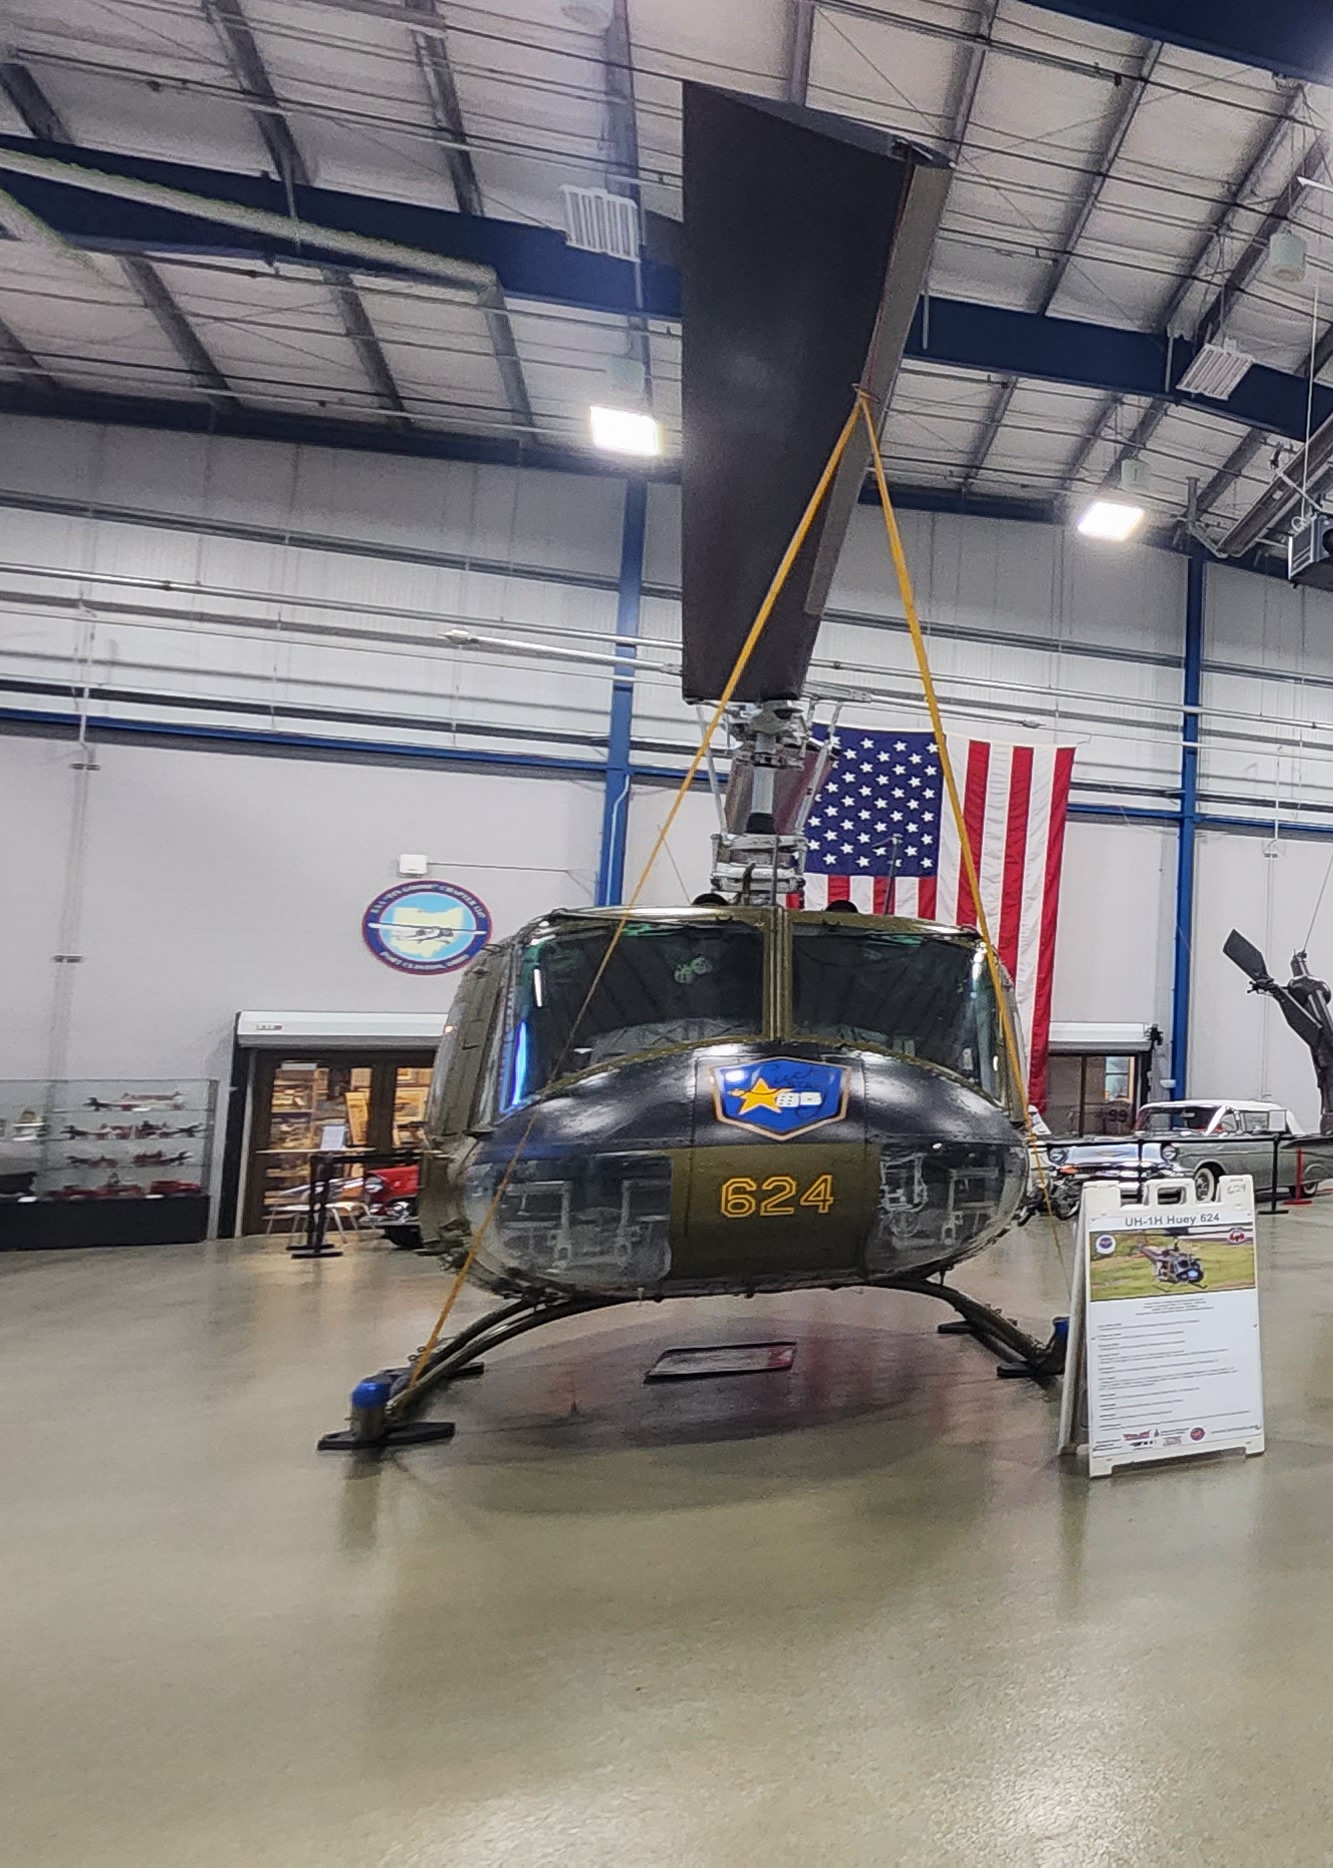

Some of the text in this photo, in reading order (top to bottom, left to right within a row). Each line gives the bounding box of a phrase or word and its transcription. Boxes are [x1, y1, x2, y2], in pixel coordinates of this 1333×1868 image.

[720, 1174, 835, 1219] 624
[1125, 1213, 1220, 1227] UH-1H Huey 624
